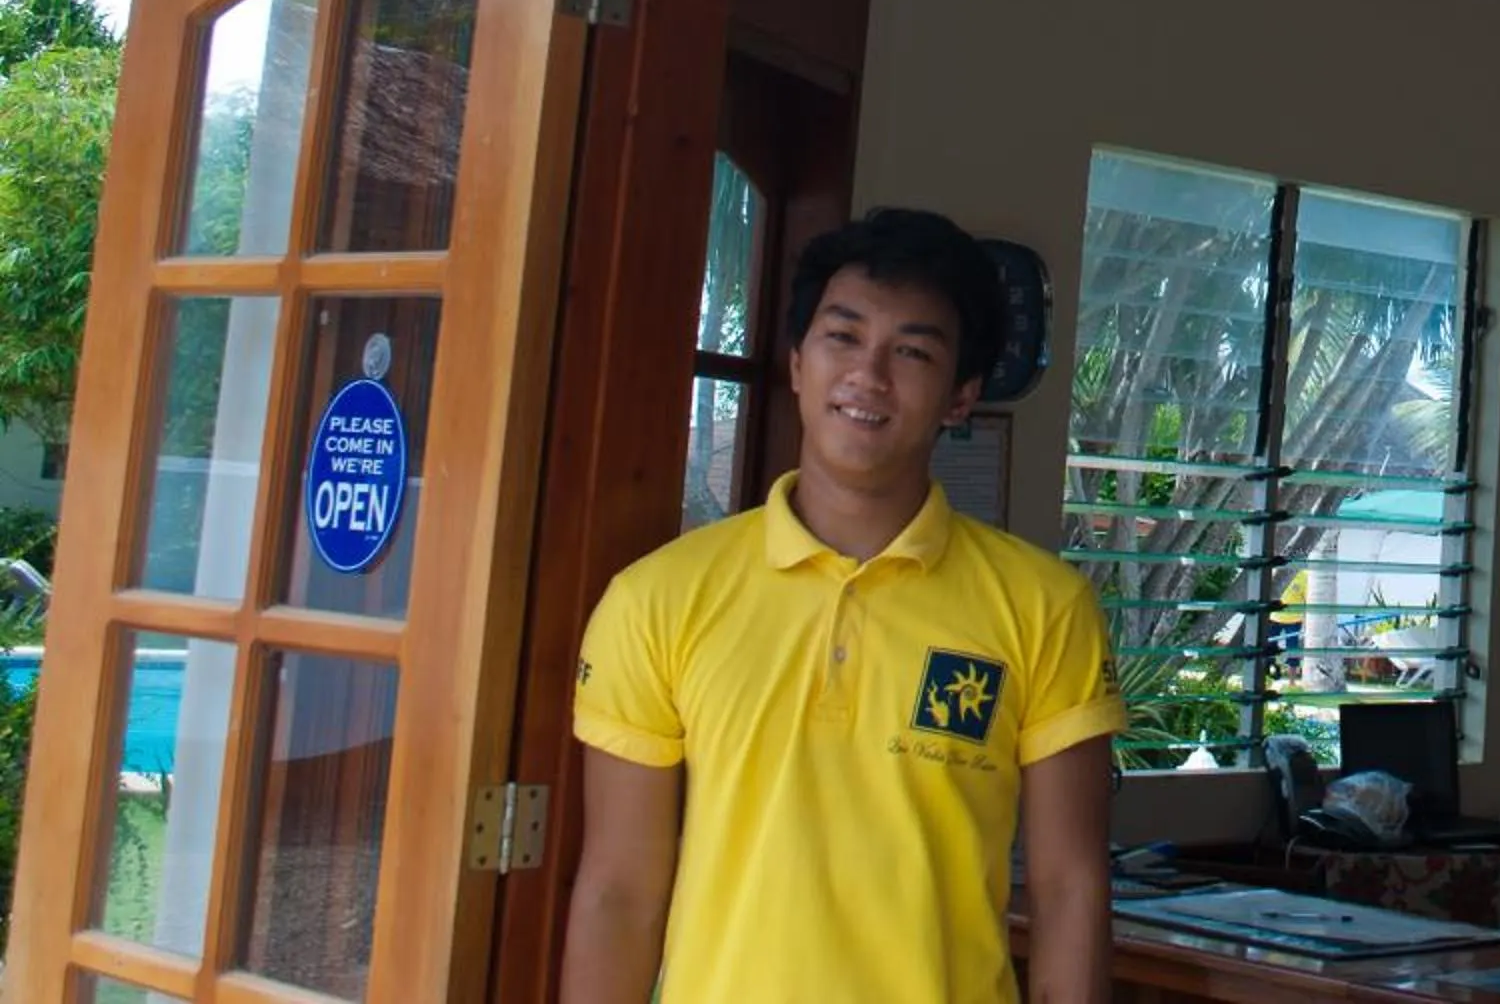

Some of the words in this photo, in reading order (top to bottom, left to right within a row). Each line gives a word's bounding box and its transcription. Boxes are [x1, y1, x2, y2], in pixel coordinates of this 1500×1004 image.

[329, 417, 393, 435] PLEASE
[325, 436, 373, 453] COME
[376, 440, 394, 455] IN
[331, 457, 384, 475] WE'RE
[315, 480, 389, 533] OPEN
